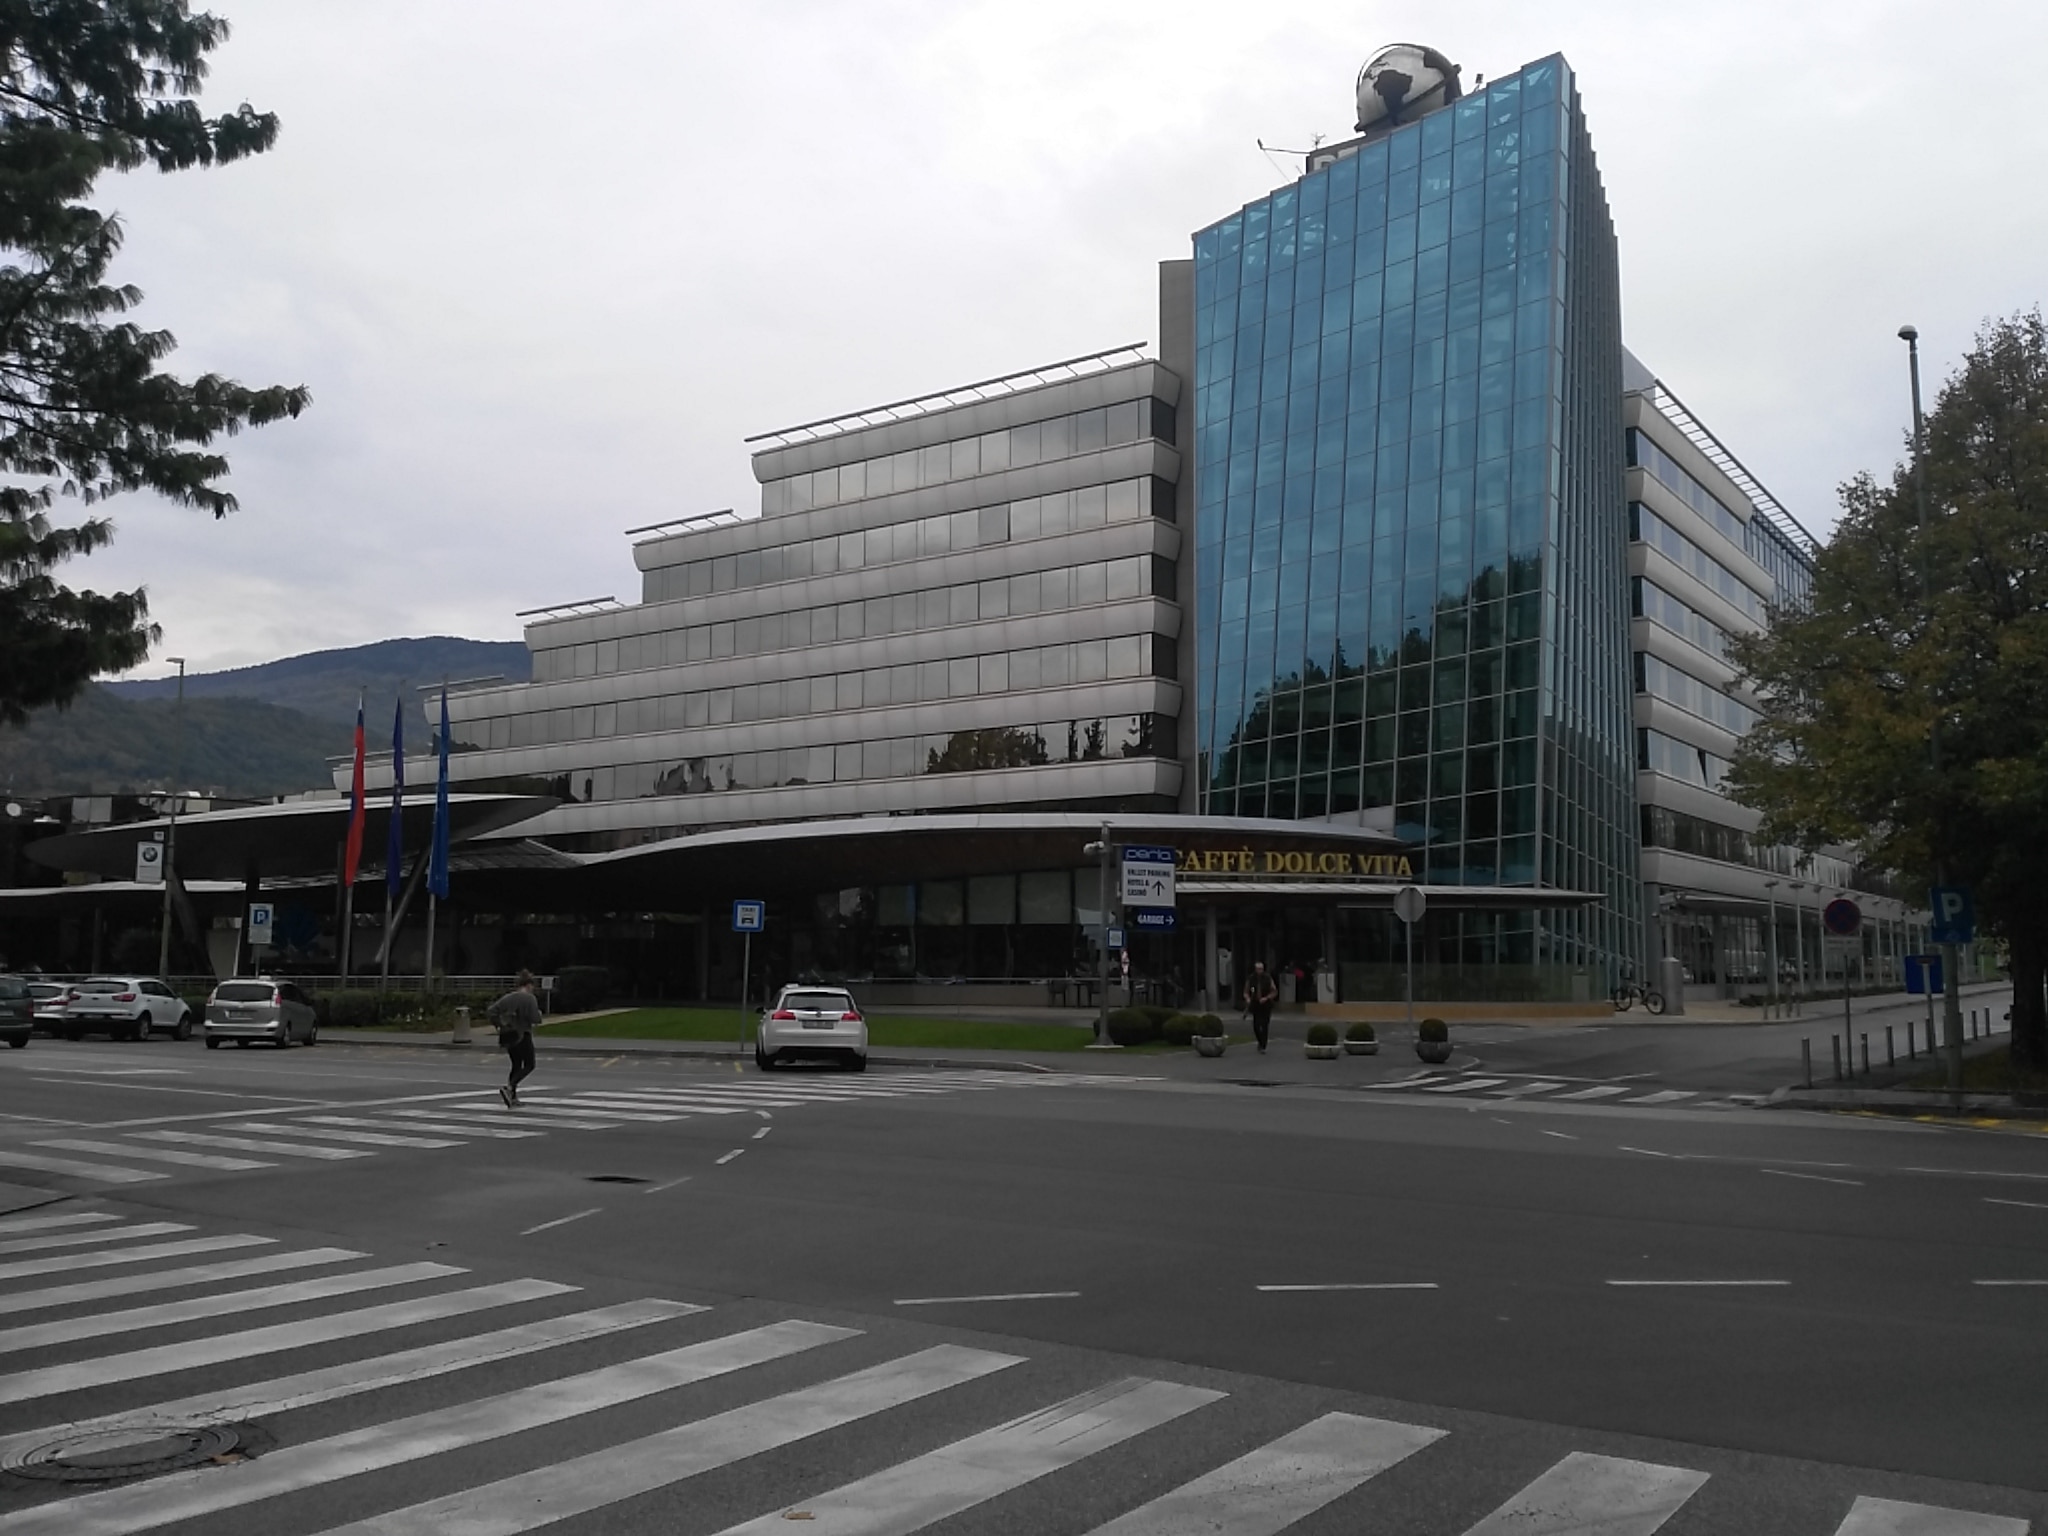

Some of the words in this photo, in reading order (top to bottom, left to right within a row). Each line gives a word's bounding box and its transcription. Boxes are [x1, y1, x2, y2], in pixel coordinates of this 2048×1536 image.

[1126, 849, 1171, 860] perla
[1264, 851, 1353, 873] DOLCE
[1357, 854, 1413, 875] VITA
[1941, 892, 1963, 922] P
[257, 911, 266, 922] P
